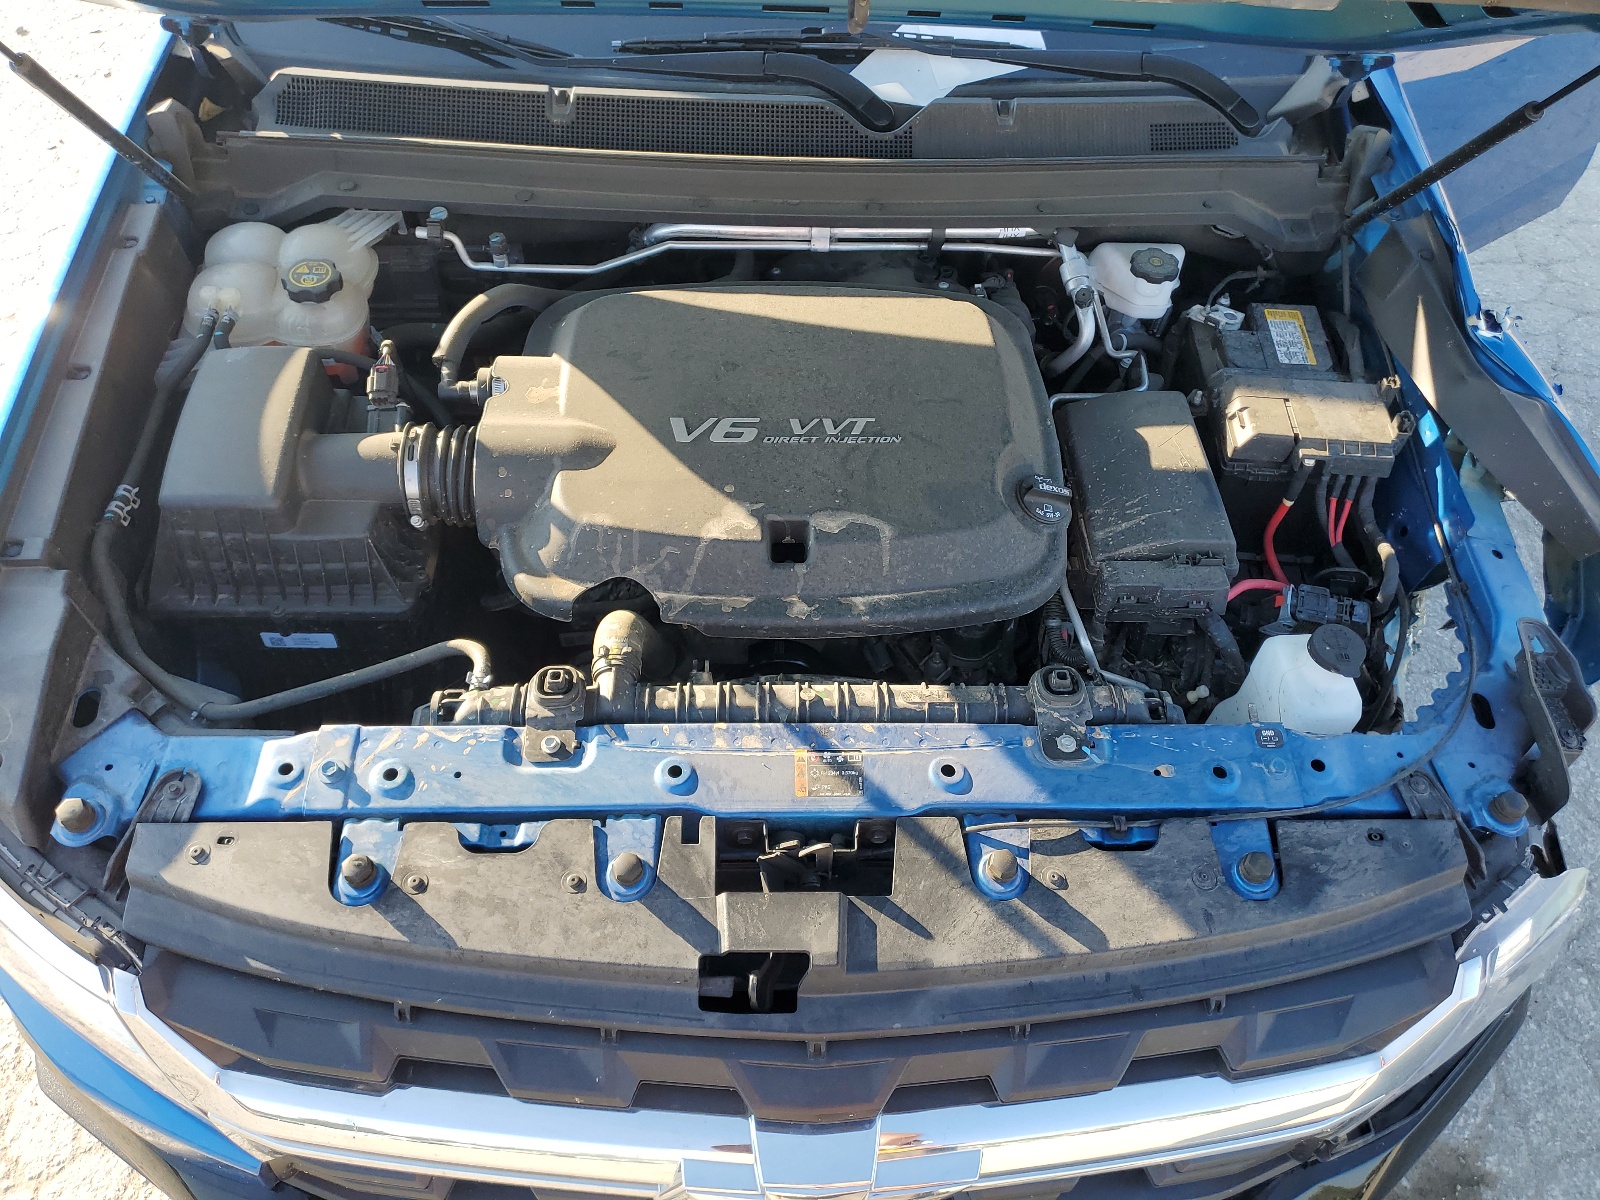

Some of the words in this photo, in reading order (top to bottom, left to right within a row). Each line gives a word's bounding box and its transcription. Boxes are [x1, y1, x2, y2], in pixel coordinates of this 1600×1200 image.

[669, 417, 761, 443] V6
[789, 418, 876, 435] VVT
[762, 436, 819, 444] DIRECT
[825, 435, 902, 444] INJECTION
